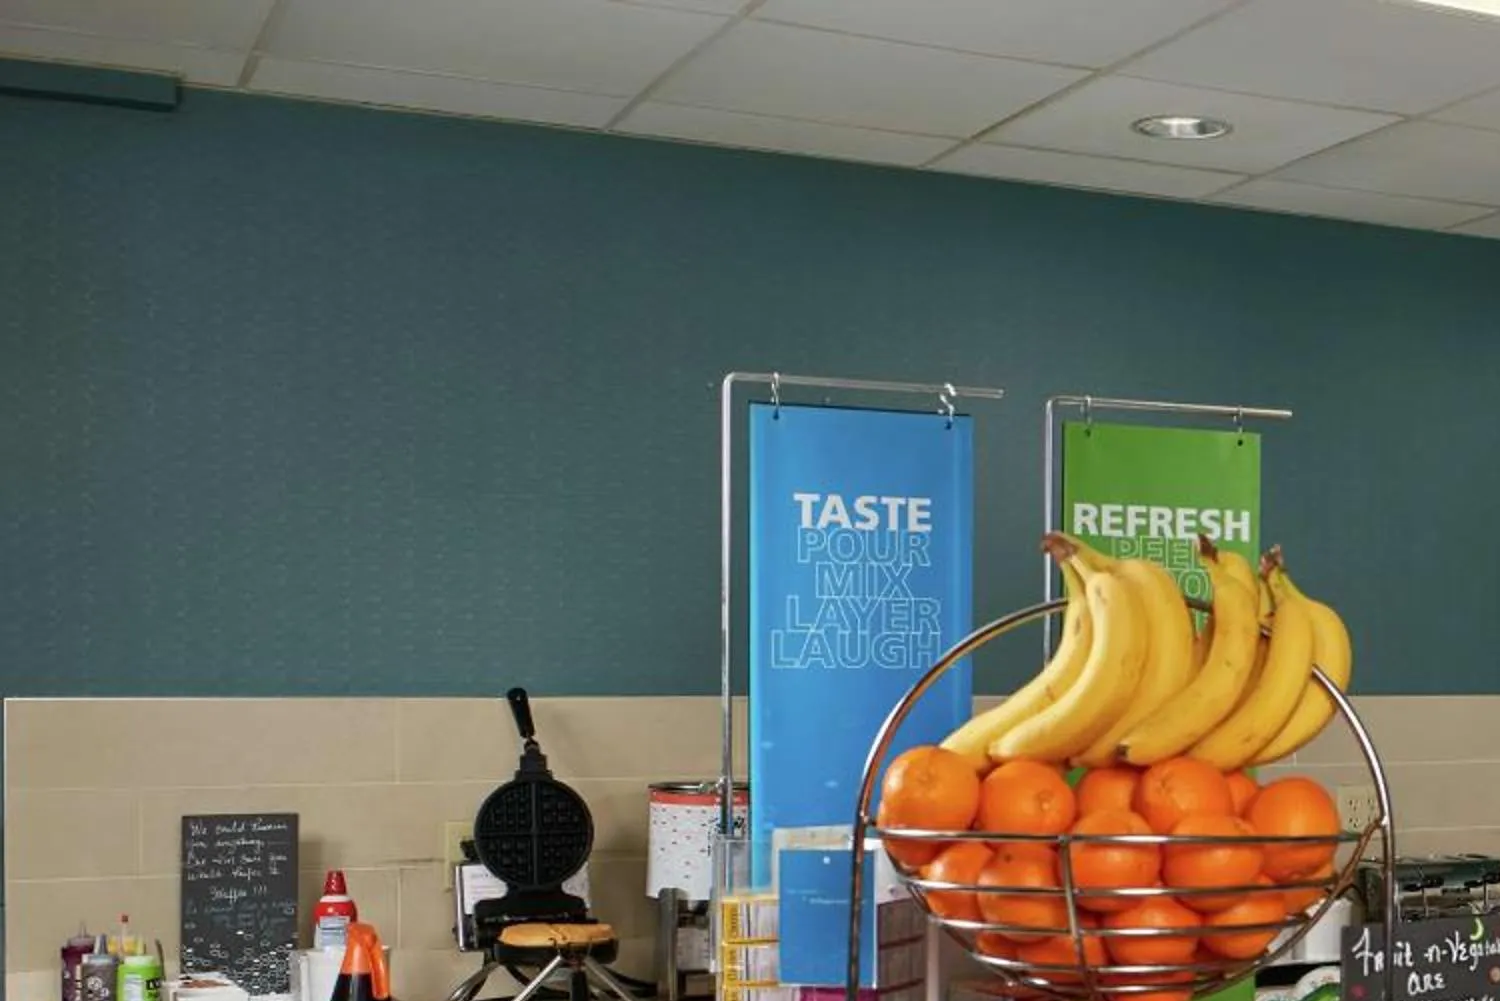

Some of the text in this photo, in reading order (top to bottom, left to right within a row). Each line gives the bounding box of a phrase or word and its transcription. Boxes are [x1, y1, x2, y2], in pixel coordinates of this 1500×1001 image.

[793, 493, 932, 532] TASTE
[1073, 503, 1250, 542] REFRESH
[797, 526, 931, 566] POUR
[815, 562, 913, 599] MIX
[786, 595, 941, 634] LAYER
